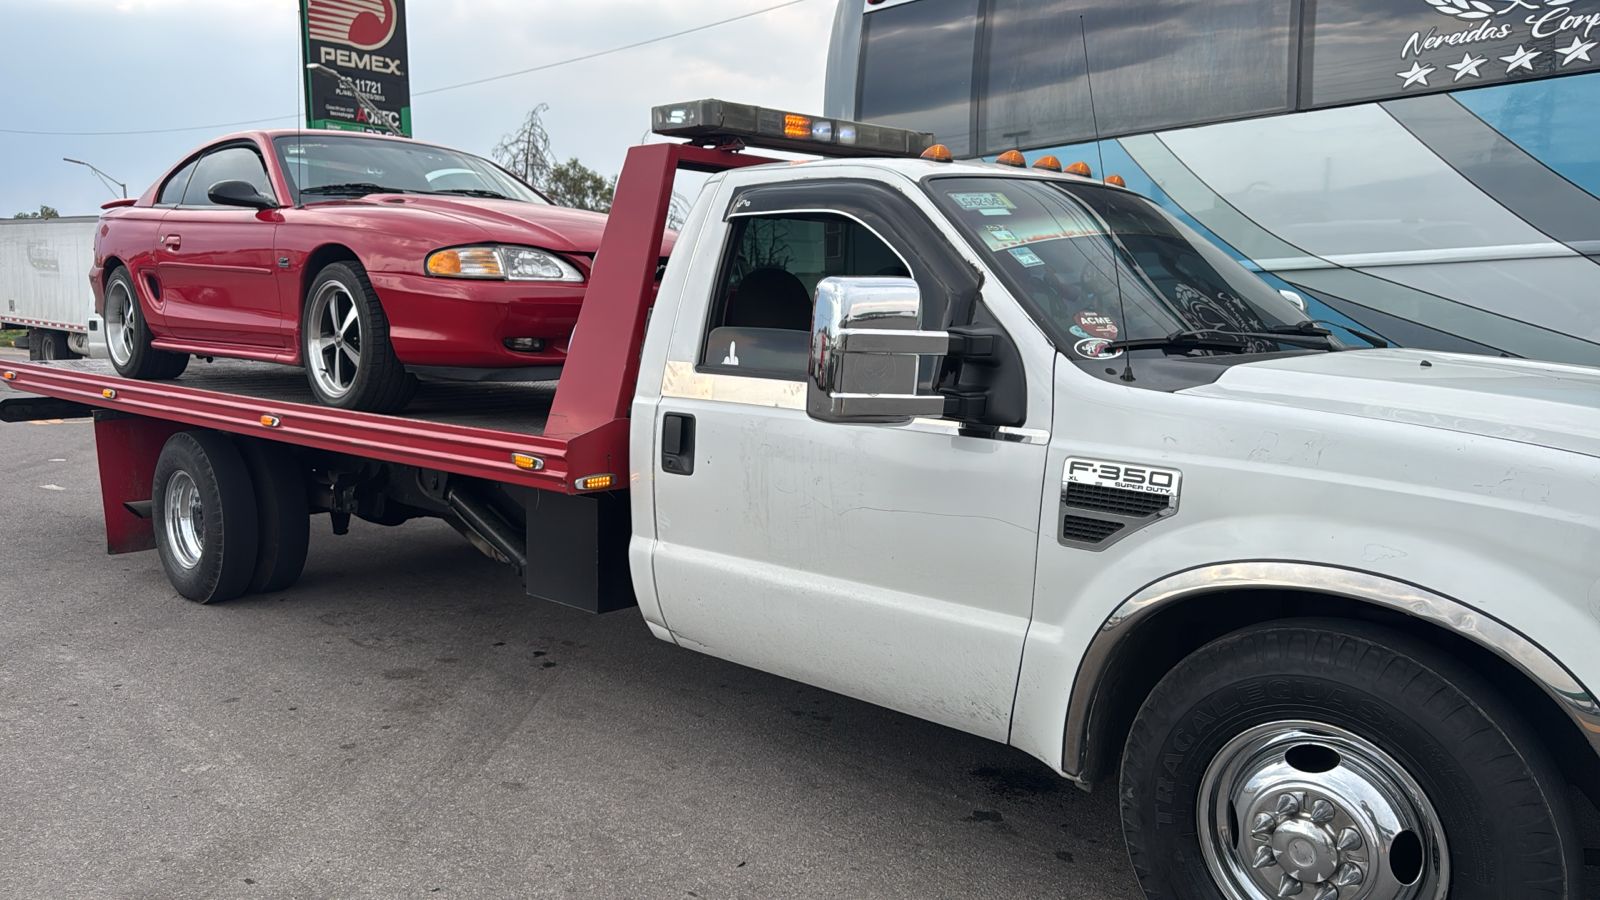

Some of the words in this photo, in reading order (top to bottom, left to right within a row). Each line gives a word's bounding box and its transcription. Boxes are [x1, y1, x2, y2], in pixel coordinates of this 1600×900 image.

[1401, 19, 1513, 59] Nereidas
[320, 46, 401, 76] PEMEX
[355, 79, 382, 94] 11721
[1080, 317, 1113, 325] ACME
[1114, 481, 1144, 490] SUPER
[1145, 485, 1171, 494] DUTY
